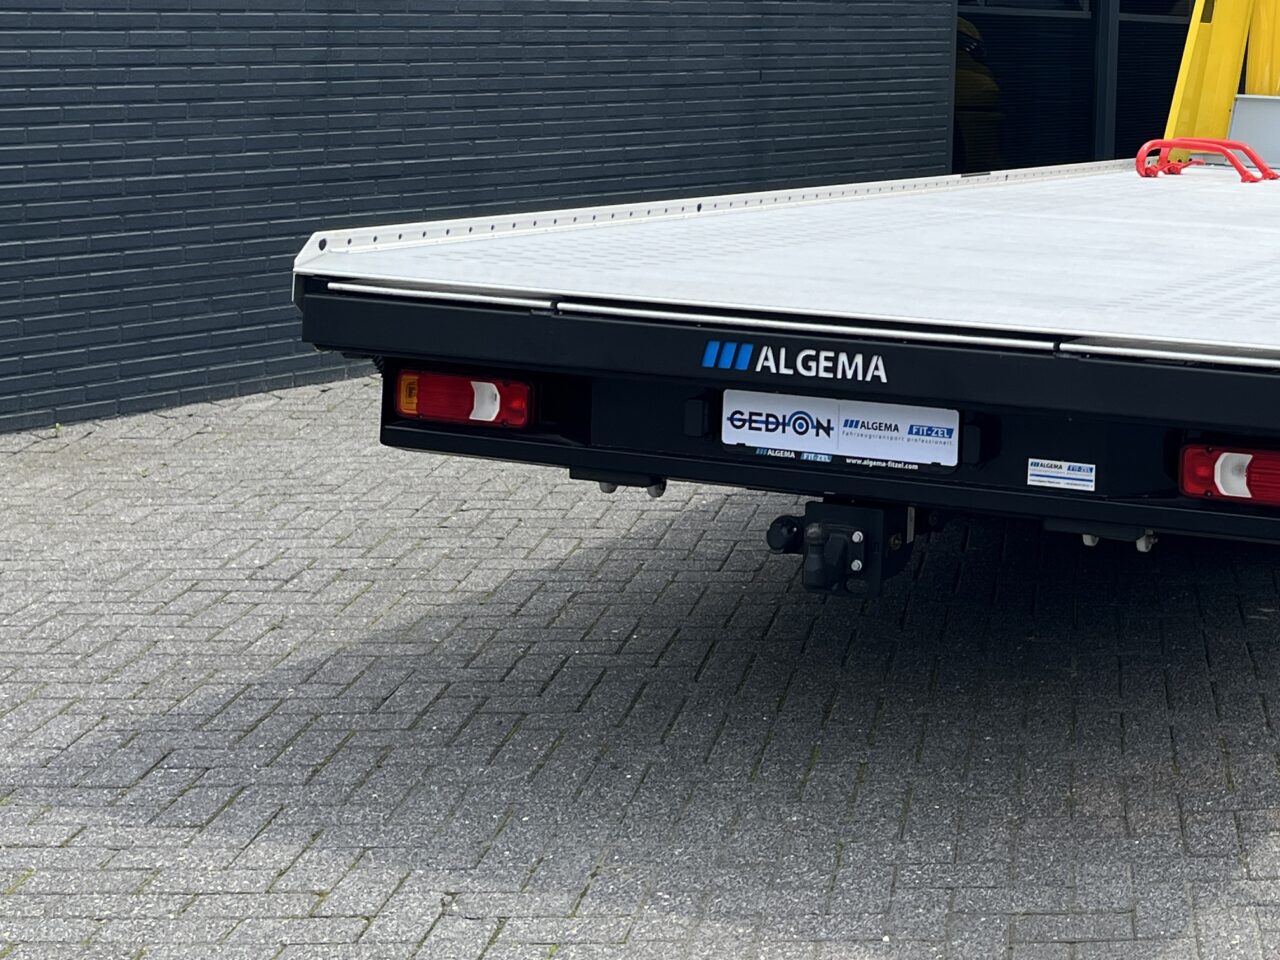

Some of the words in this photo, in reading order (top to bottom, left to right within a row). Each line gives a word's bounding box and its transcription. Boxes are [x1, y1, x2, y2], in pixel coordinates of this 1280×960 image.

[755, 345, 888, 383] ALGEMA
[729, 410, 831, 438] GEDION
[859, 420, 899, 433] ALGEMA
[912, 425, 950, 438] FIT-ZEL
[767, 449, 796, 458] ALGEMA
[1040, 462, 1063, 470] ALGEMA
